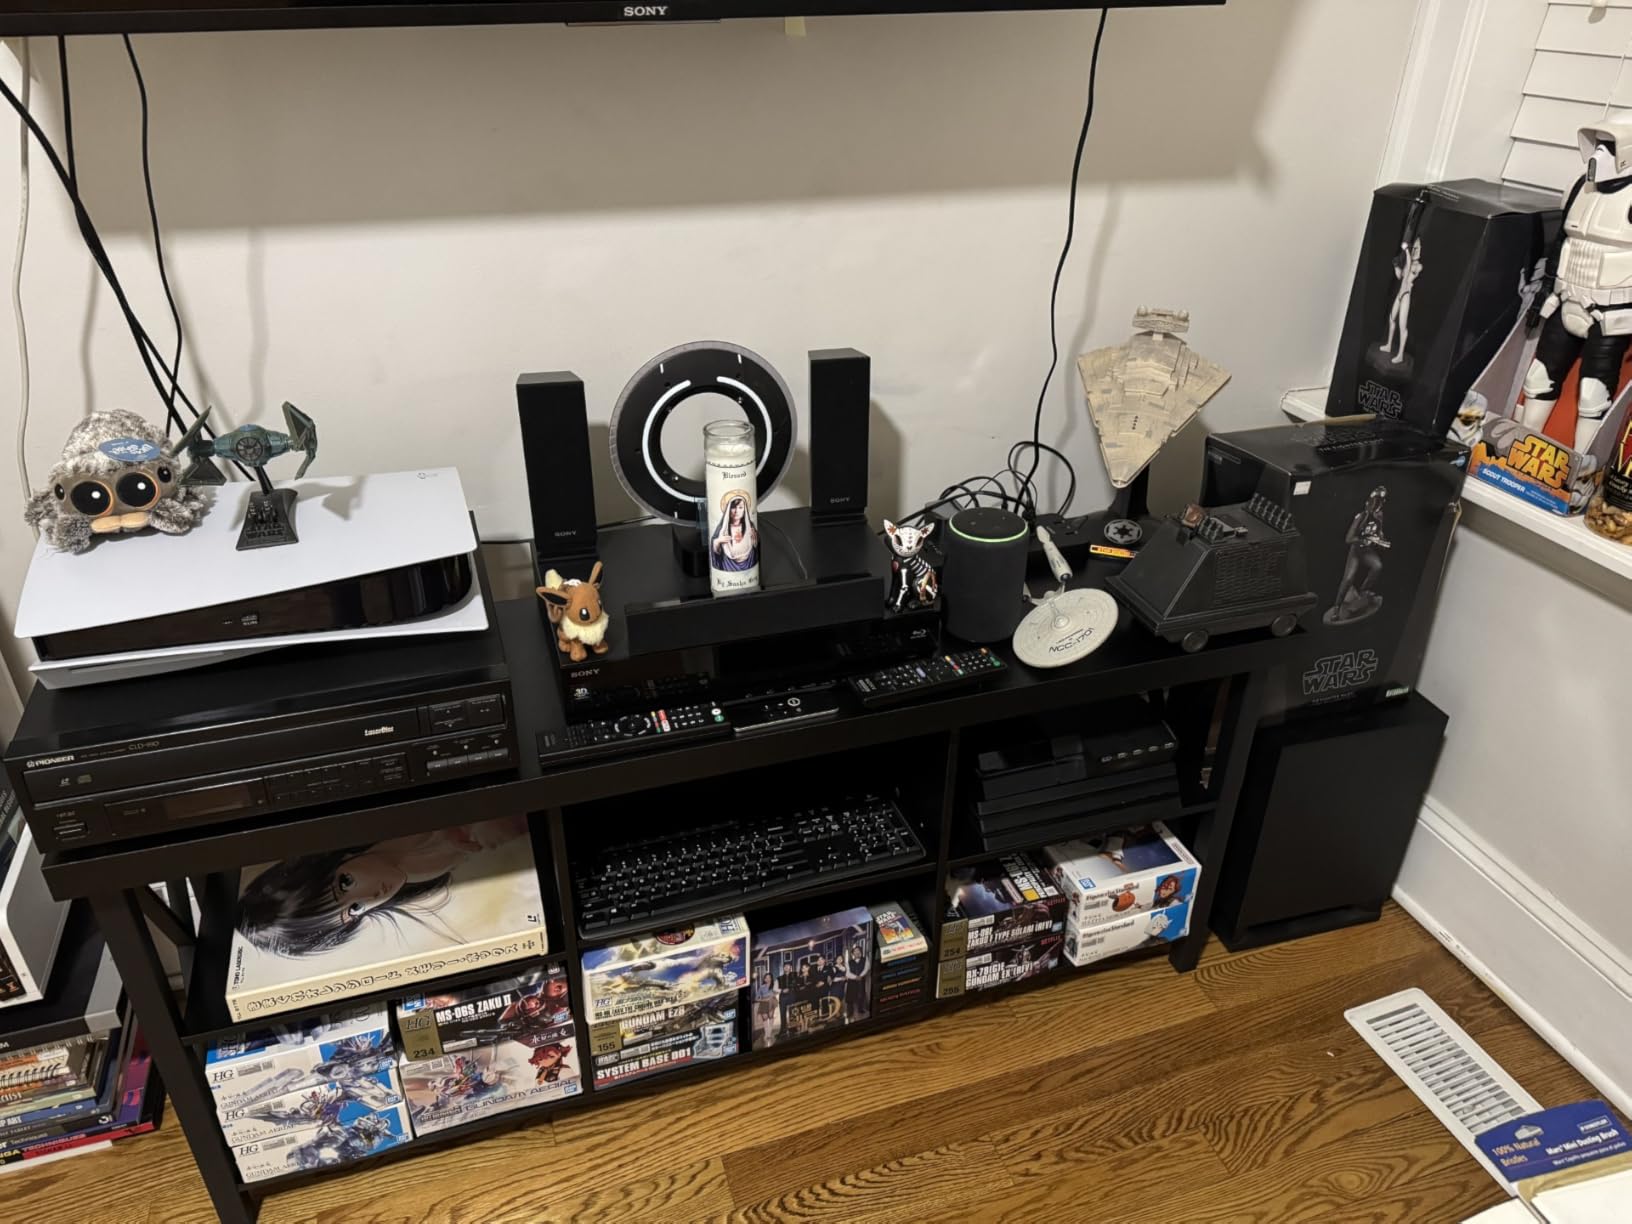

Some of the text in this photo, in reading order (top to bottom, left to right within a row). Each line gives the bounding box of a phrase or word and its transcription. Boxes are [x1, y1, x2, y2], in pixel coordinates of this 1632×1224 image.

[624, 6, 668, 16] SONY
[1360, 380, 1402, 406] STAR
[1359, 389, 1402, 420] WARS
[1511, 434, 1571, 472] STAR
[1506, 445, 1571, 489] WARS
[1482, 467, 1526, 493] SCOUT TROOPER
[1303, 649, 1379, 676] STAR
[571, 668, 600, 678] SONY
[1303, 663, 1378, 695] WARS
[35, 754, 75, 768] PIONEER
[436, 1003, 475, 1023] MS-06S
[477, 997, 503, 1015] ZAKU
[404, 1015, 431, 1031] HG
[620, 1011, 665, 1029] GUNDAM
[413, 1049, 435, 1059] 234
[597, 1041, 616, 1052] 155
[596, 1061, 640, 1080] SYSTEM
[641, 1054, 670, 1069] BASE
[671, 1047, 692, 1061] 001
[213, 1069, 234, 1082] HG
[224, 1108, 246, 1121] HG
[1599, 1128, 1620, 1141] Brush
[238, 1144, 260, 1157] HG
[1492, 1138, 1541, 1157] 100% Natural
